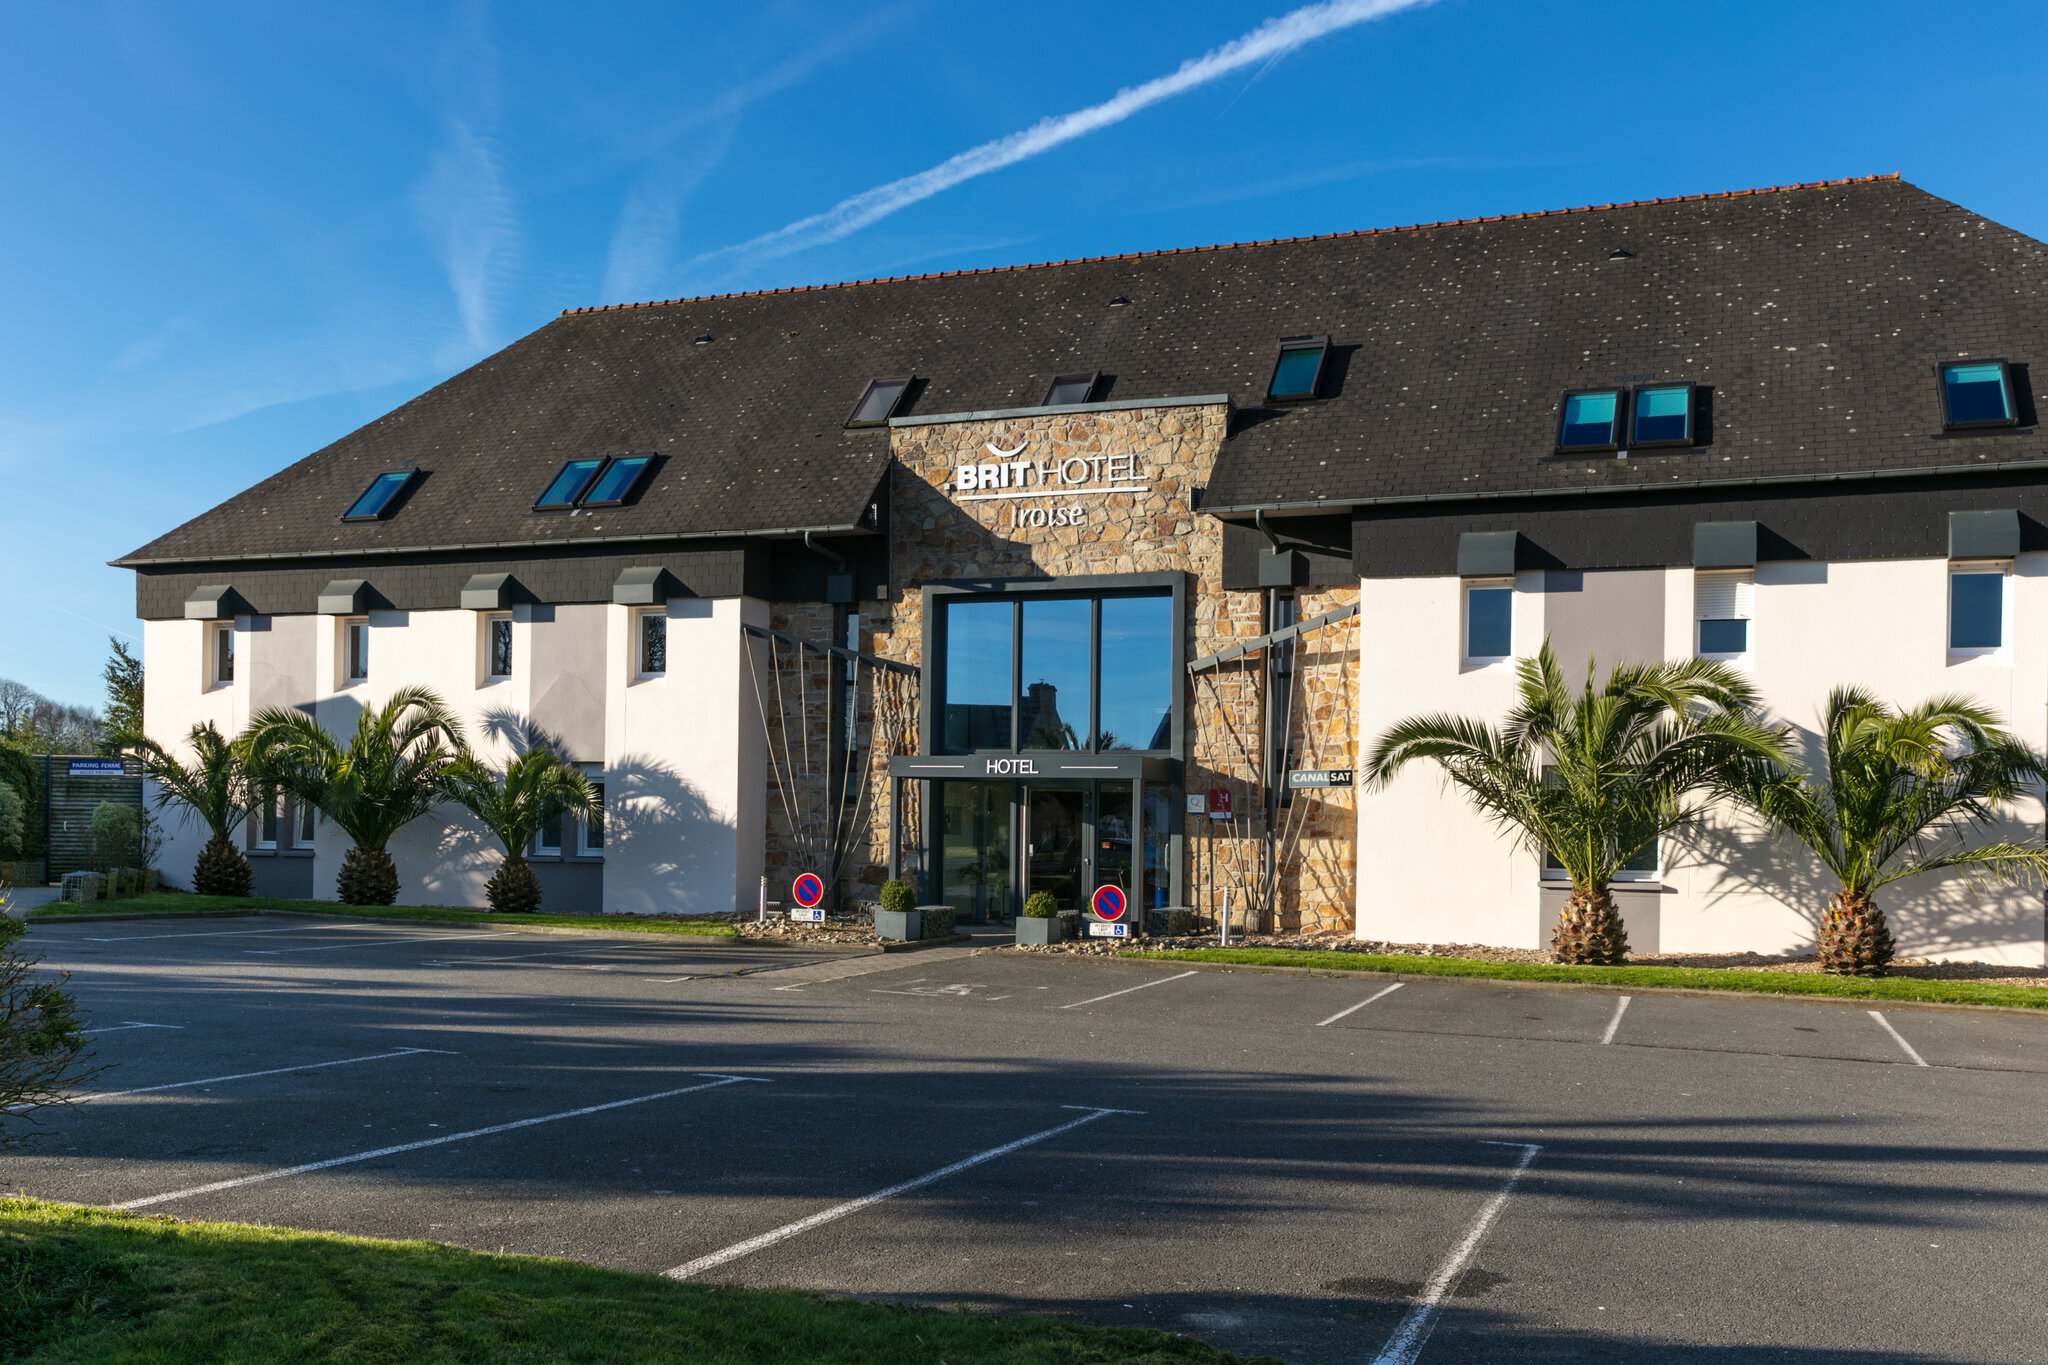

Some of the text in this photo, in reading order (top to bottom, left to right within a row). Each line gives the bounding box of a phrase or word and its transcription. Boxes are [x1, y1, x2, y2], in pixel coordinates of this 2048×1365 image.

[957, 454, 1149, 491] BRIT HOTEL
[1010, 500, 1085, 529] Iroise
[986, 758, 1039, 774] HOTEL
